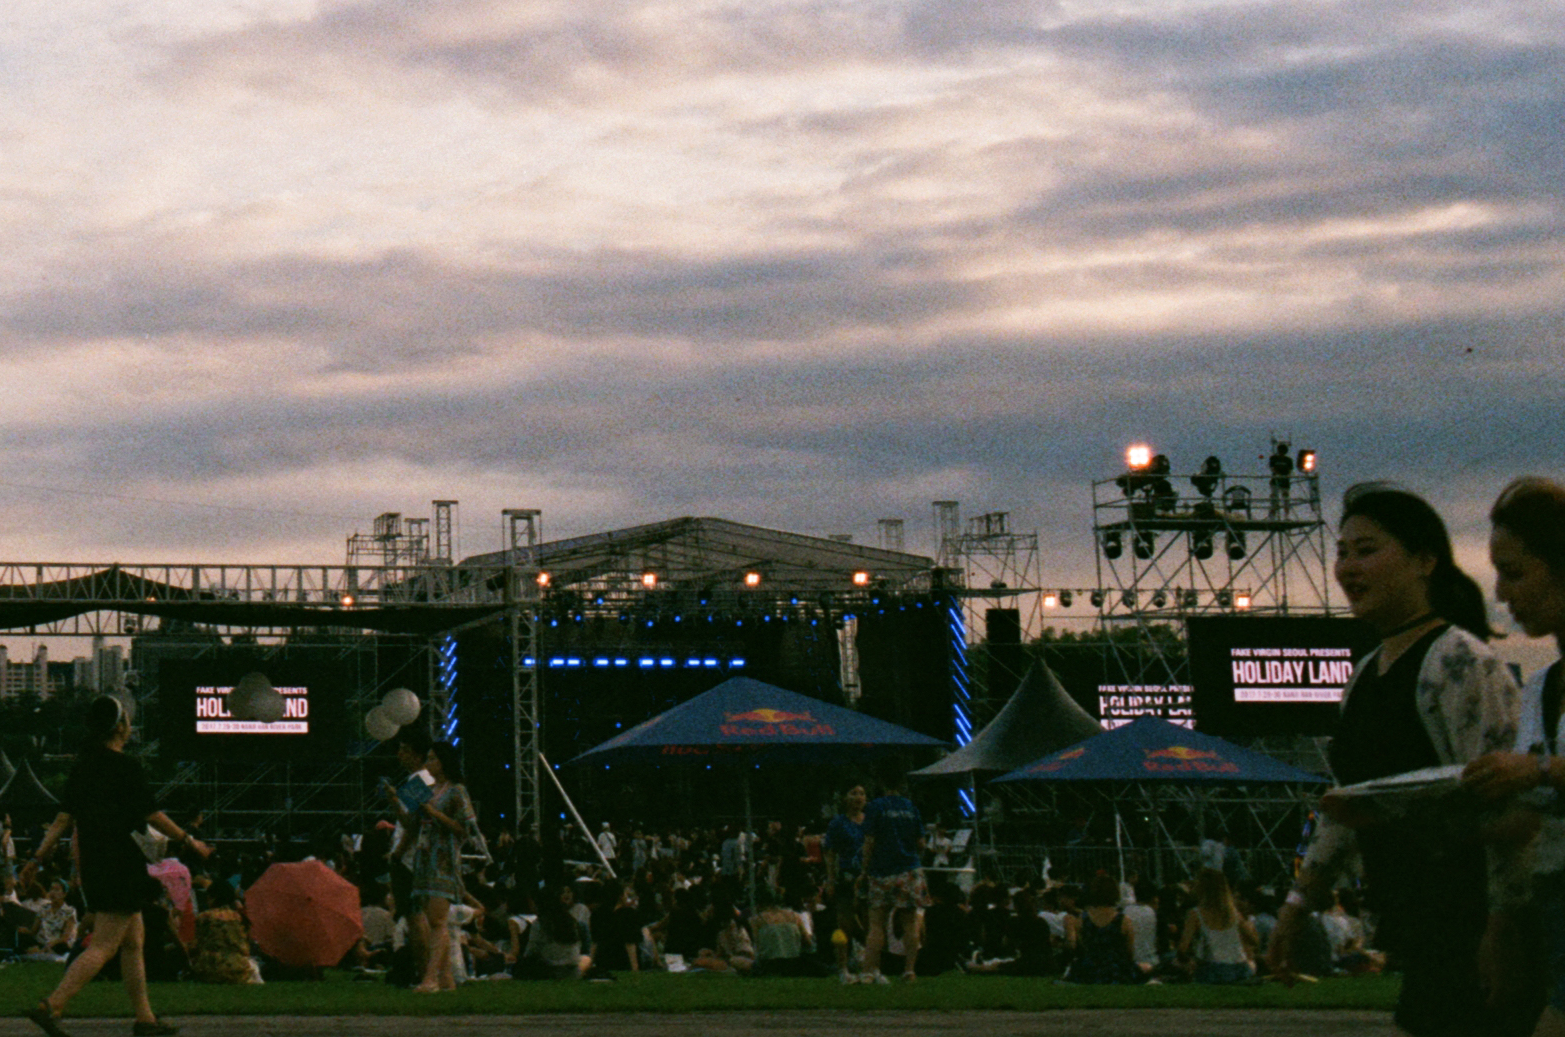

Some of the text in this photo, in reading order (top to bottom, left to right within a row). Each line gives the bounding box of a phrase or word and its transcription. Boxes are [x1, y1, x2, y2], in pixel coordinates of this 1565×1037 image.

[1231, 648, 1352, 657] FAKE VIRGIN SEOUL PRESENTS
[1232, 660, 1354, 683] HOLIDAY LAND
[719, 723, 835, 736] Red Bull
